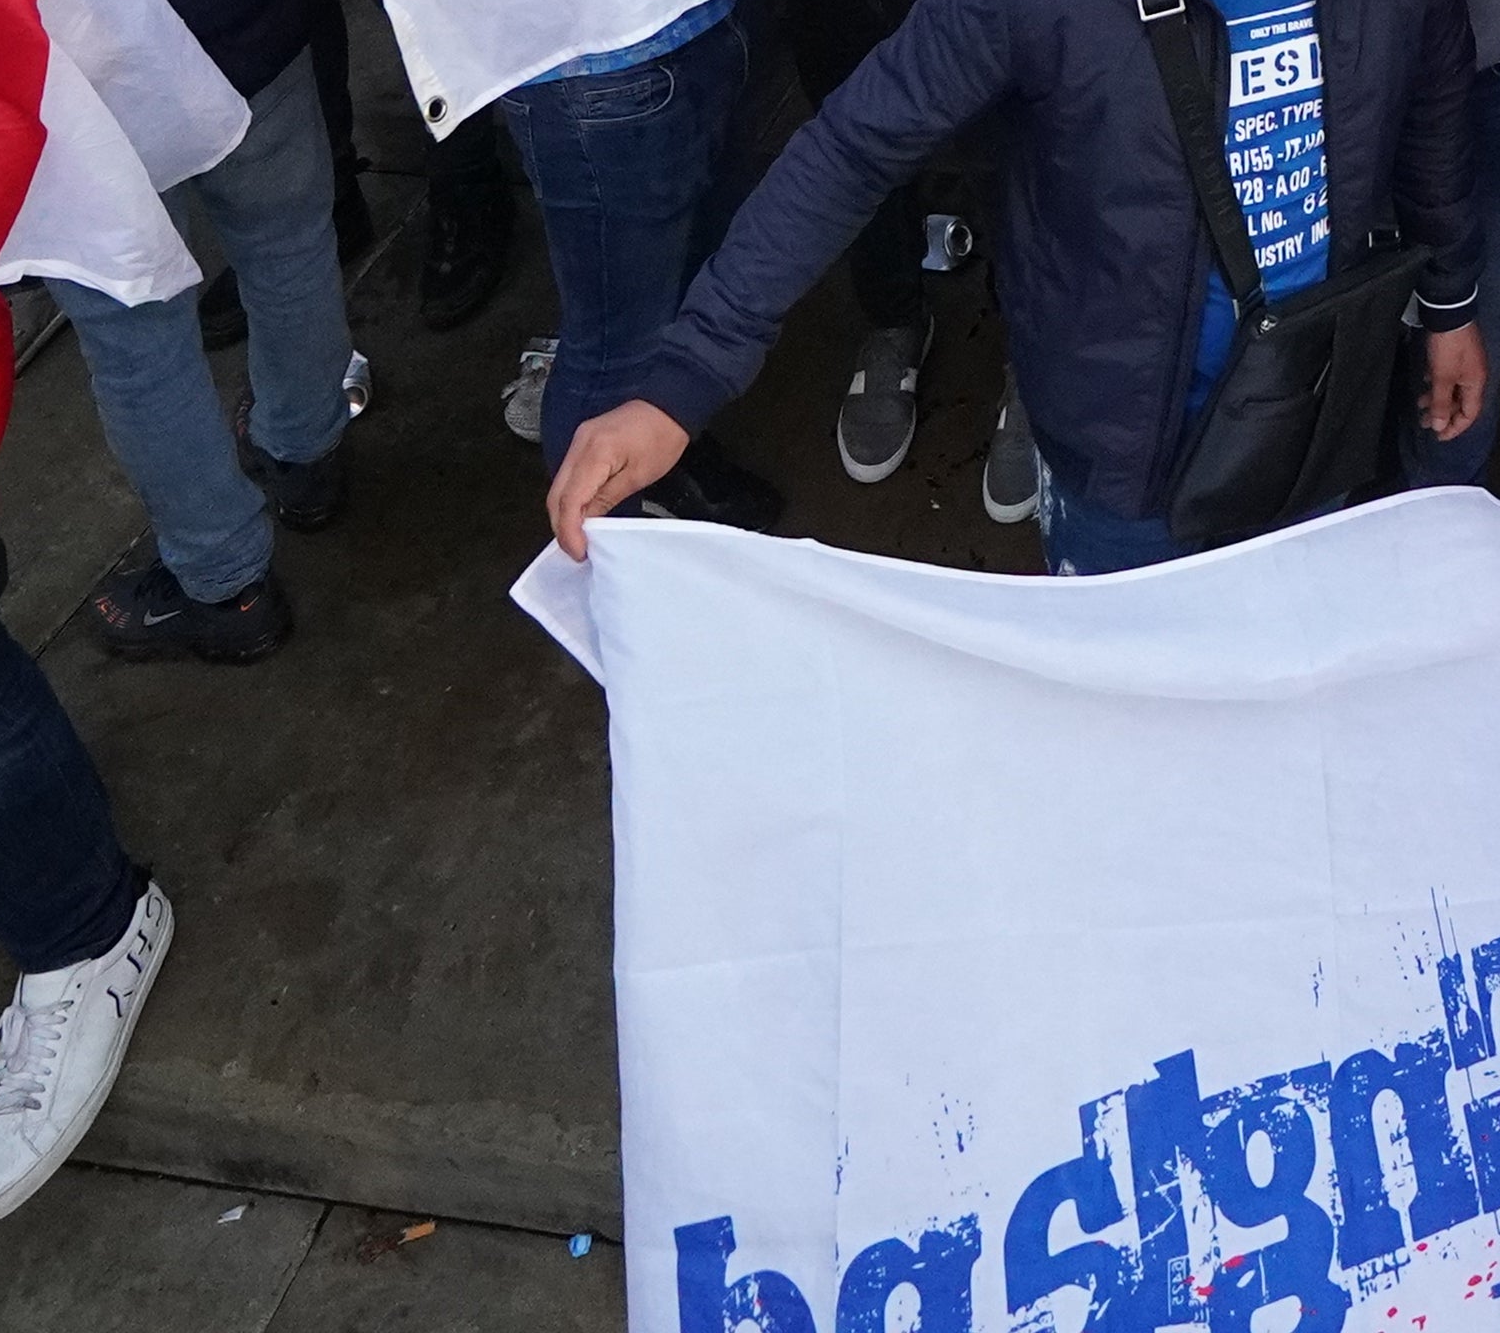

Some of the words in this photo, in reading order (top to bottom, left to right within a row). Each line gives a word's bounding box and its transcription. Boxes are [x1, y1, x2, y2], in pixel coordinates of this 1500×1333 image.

[1250, 26, 1271, 39] ONLY
[1271, 22, 1287, 35] THE
[1288, 17, 1314, 32] BRAVE
[1235, 111, 1279, 143] SPEC.
[1281, 98, 1324, 127] TYPE
[1260, 209, 1288, 234] No.
